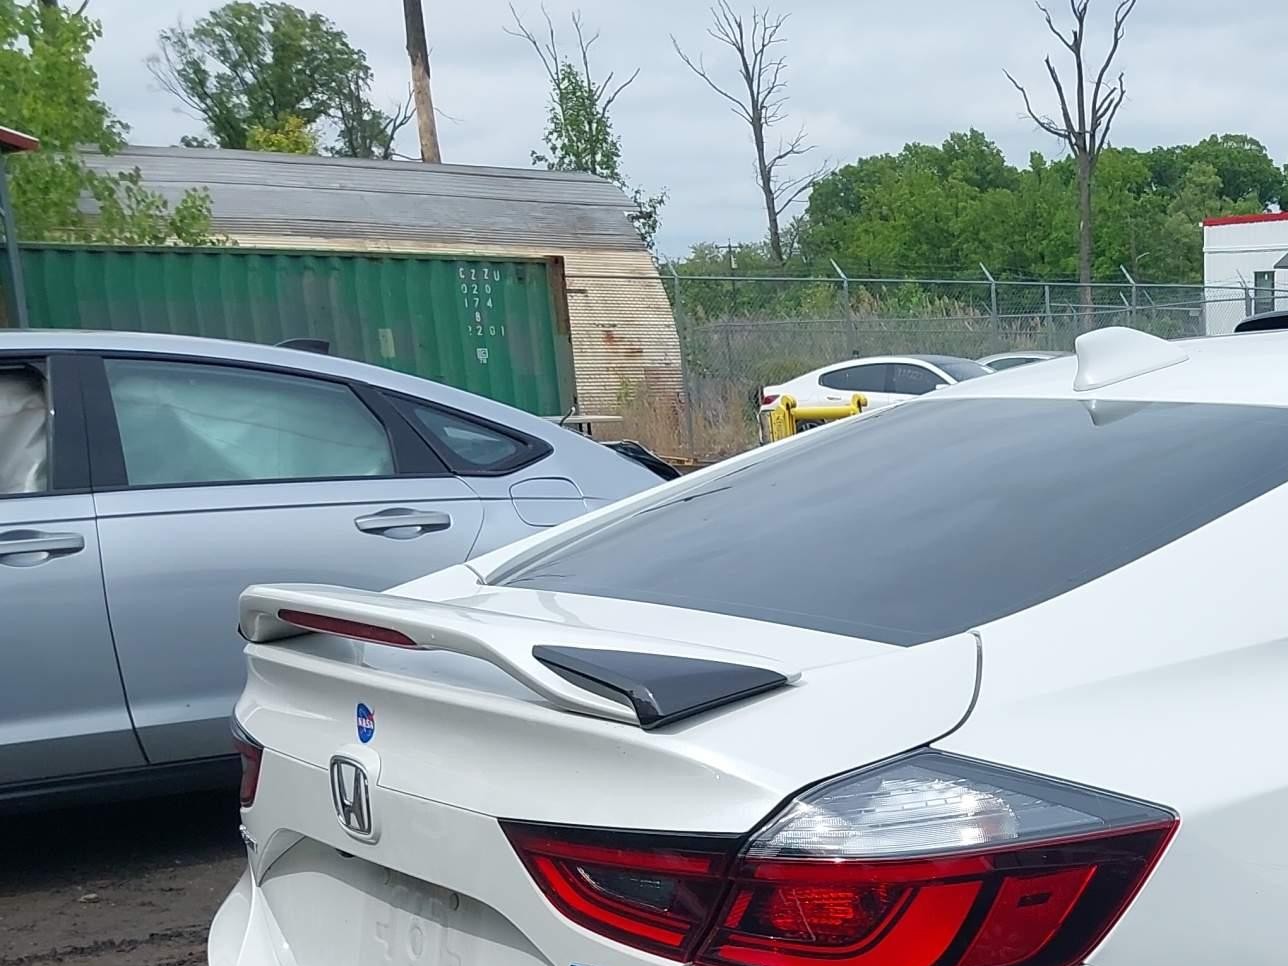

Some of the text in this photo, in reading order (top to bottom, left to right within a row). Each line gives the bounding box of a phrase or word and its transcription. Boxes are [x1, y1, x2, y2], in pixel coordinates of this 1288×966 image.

[460, 284, 491, 294] 020
[464, 298, 493, 308] 174
[358, 717, 373, 729] NASA
